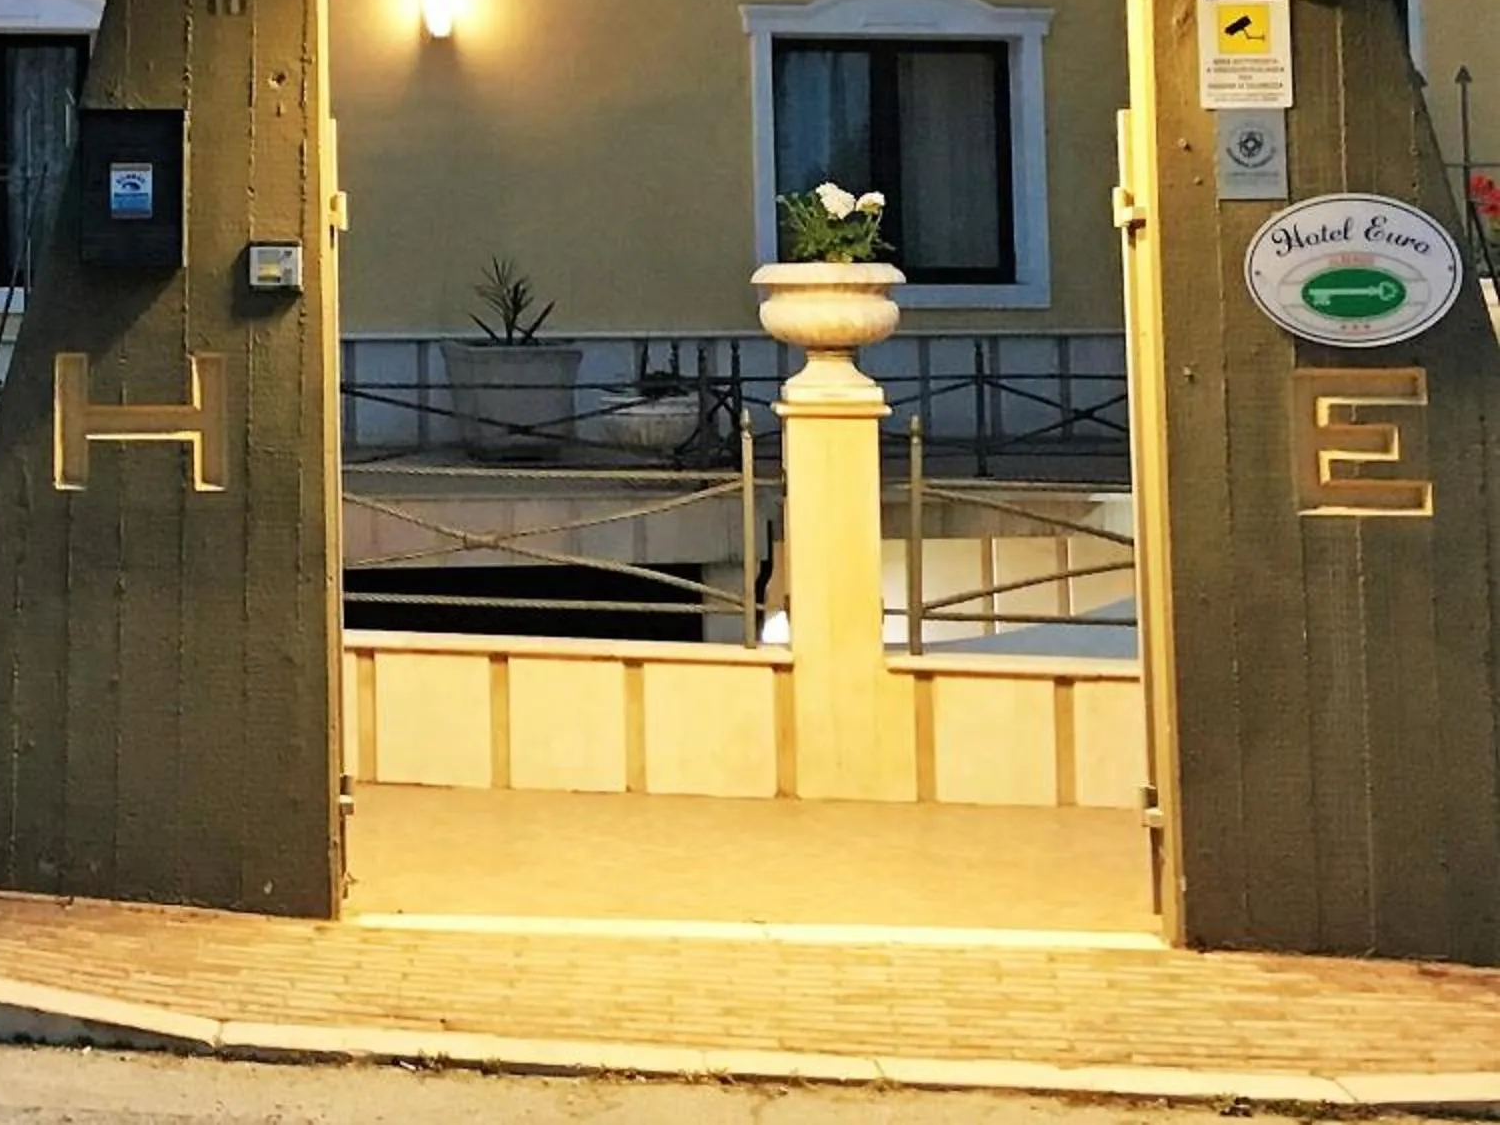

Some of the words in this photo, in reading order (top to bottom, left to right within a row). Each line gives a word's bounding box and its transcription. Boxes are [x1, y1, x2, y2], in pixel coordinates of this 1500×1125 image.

[1271, 217, 1353, 257] Hotel
[1364, 215, 1431, 254] Euro
[53, 352, 228, 491] H
[1293, 368, 1433, 516] E
